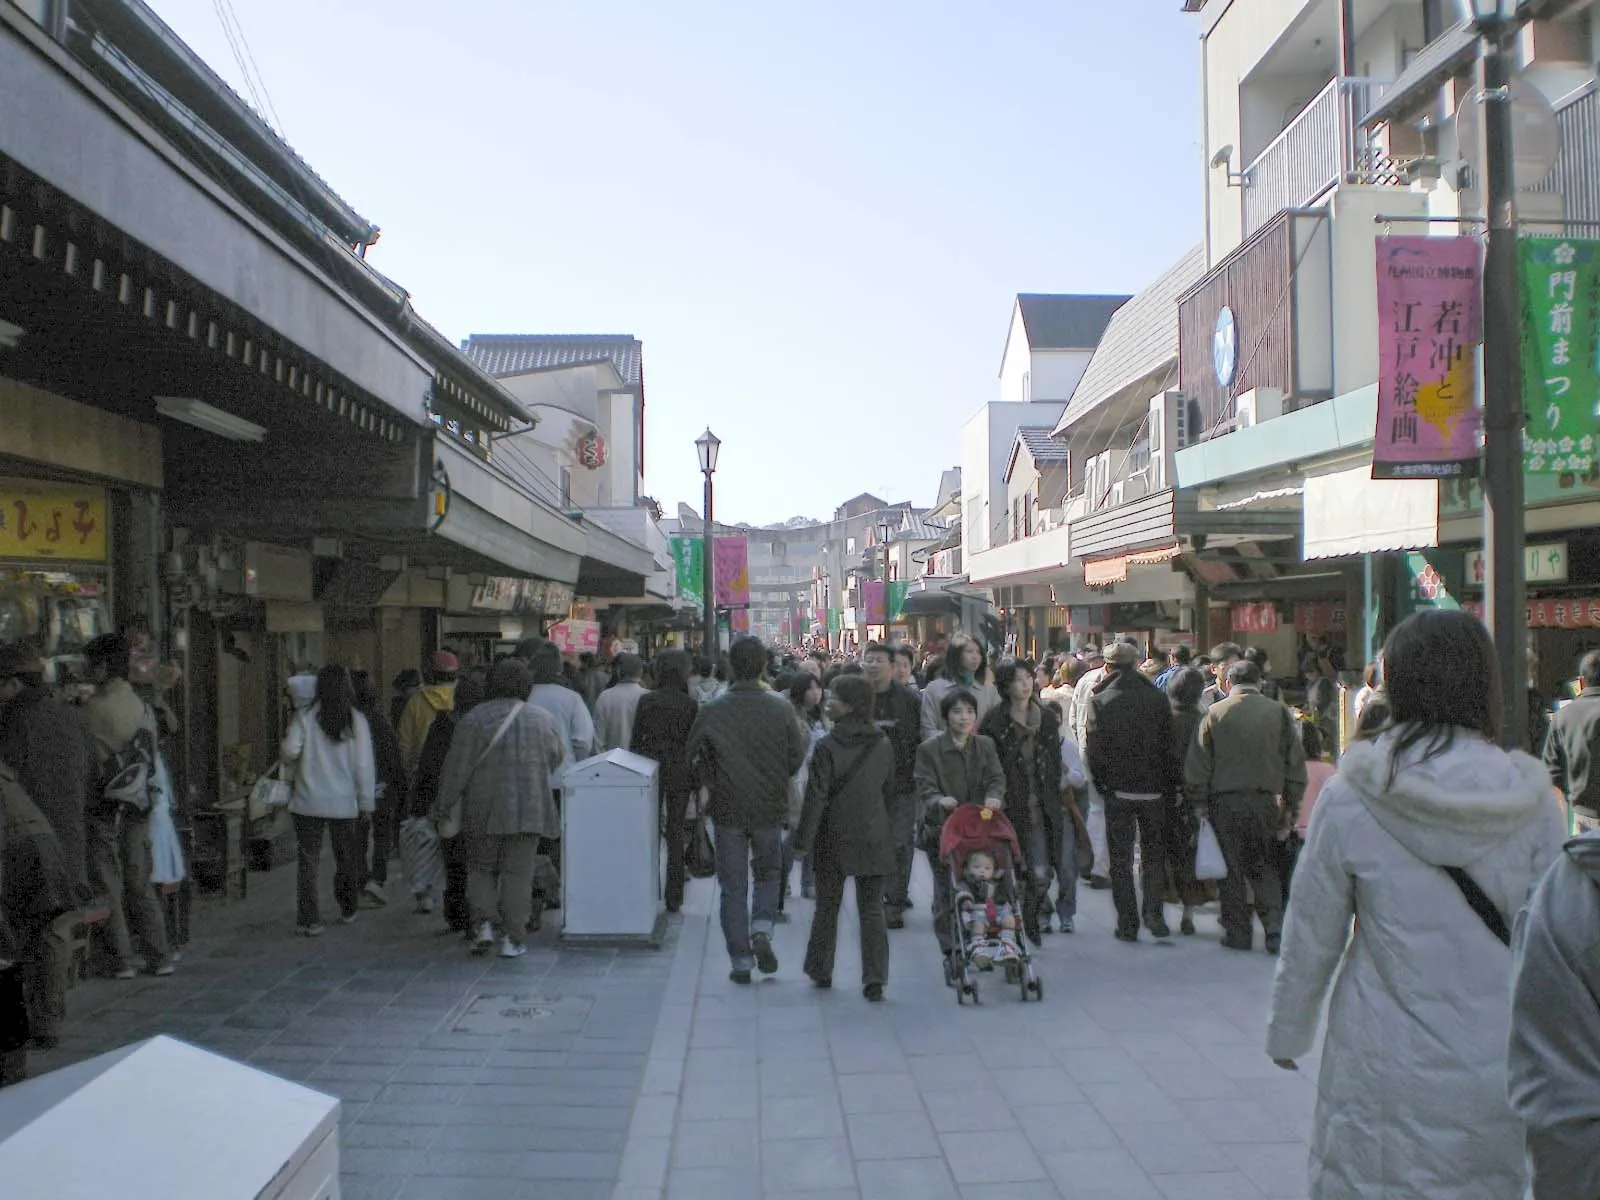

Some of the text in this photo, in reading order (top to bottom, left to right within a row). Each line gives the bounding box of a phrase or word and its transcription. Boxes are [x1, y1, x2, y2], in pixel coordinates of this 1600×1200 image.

[1391, 301, 1422, 444] 江戸絵画
[1430, 301, 1463, 400] 若冲と
[1546, 271, 1577, 431] 門前まつり
